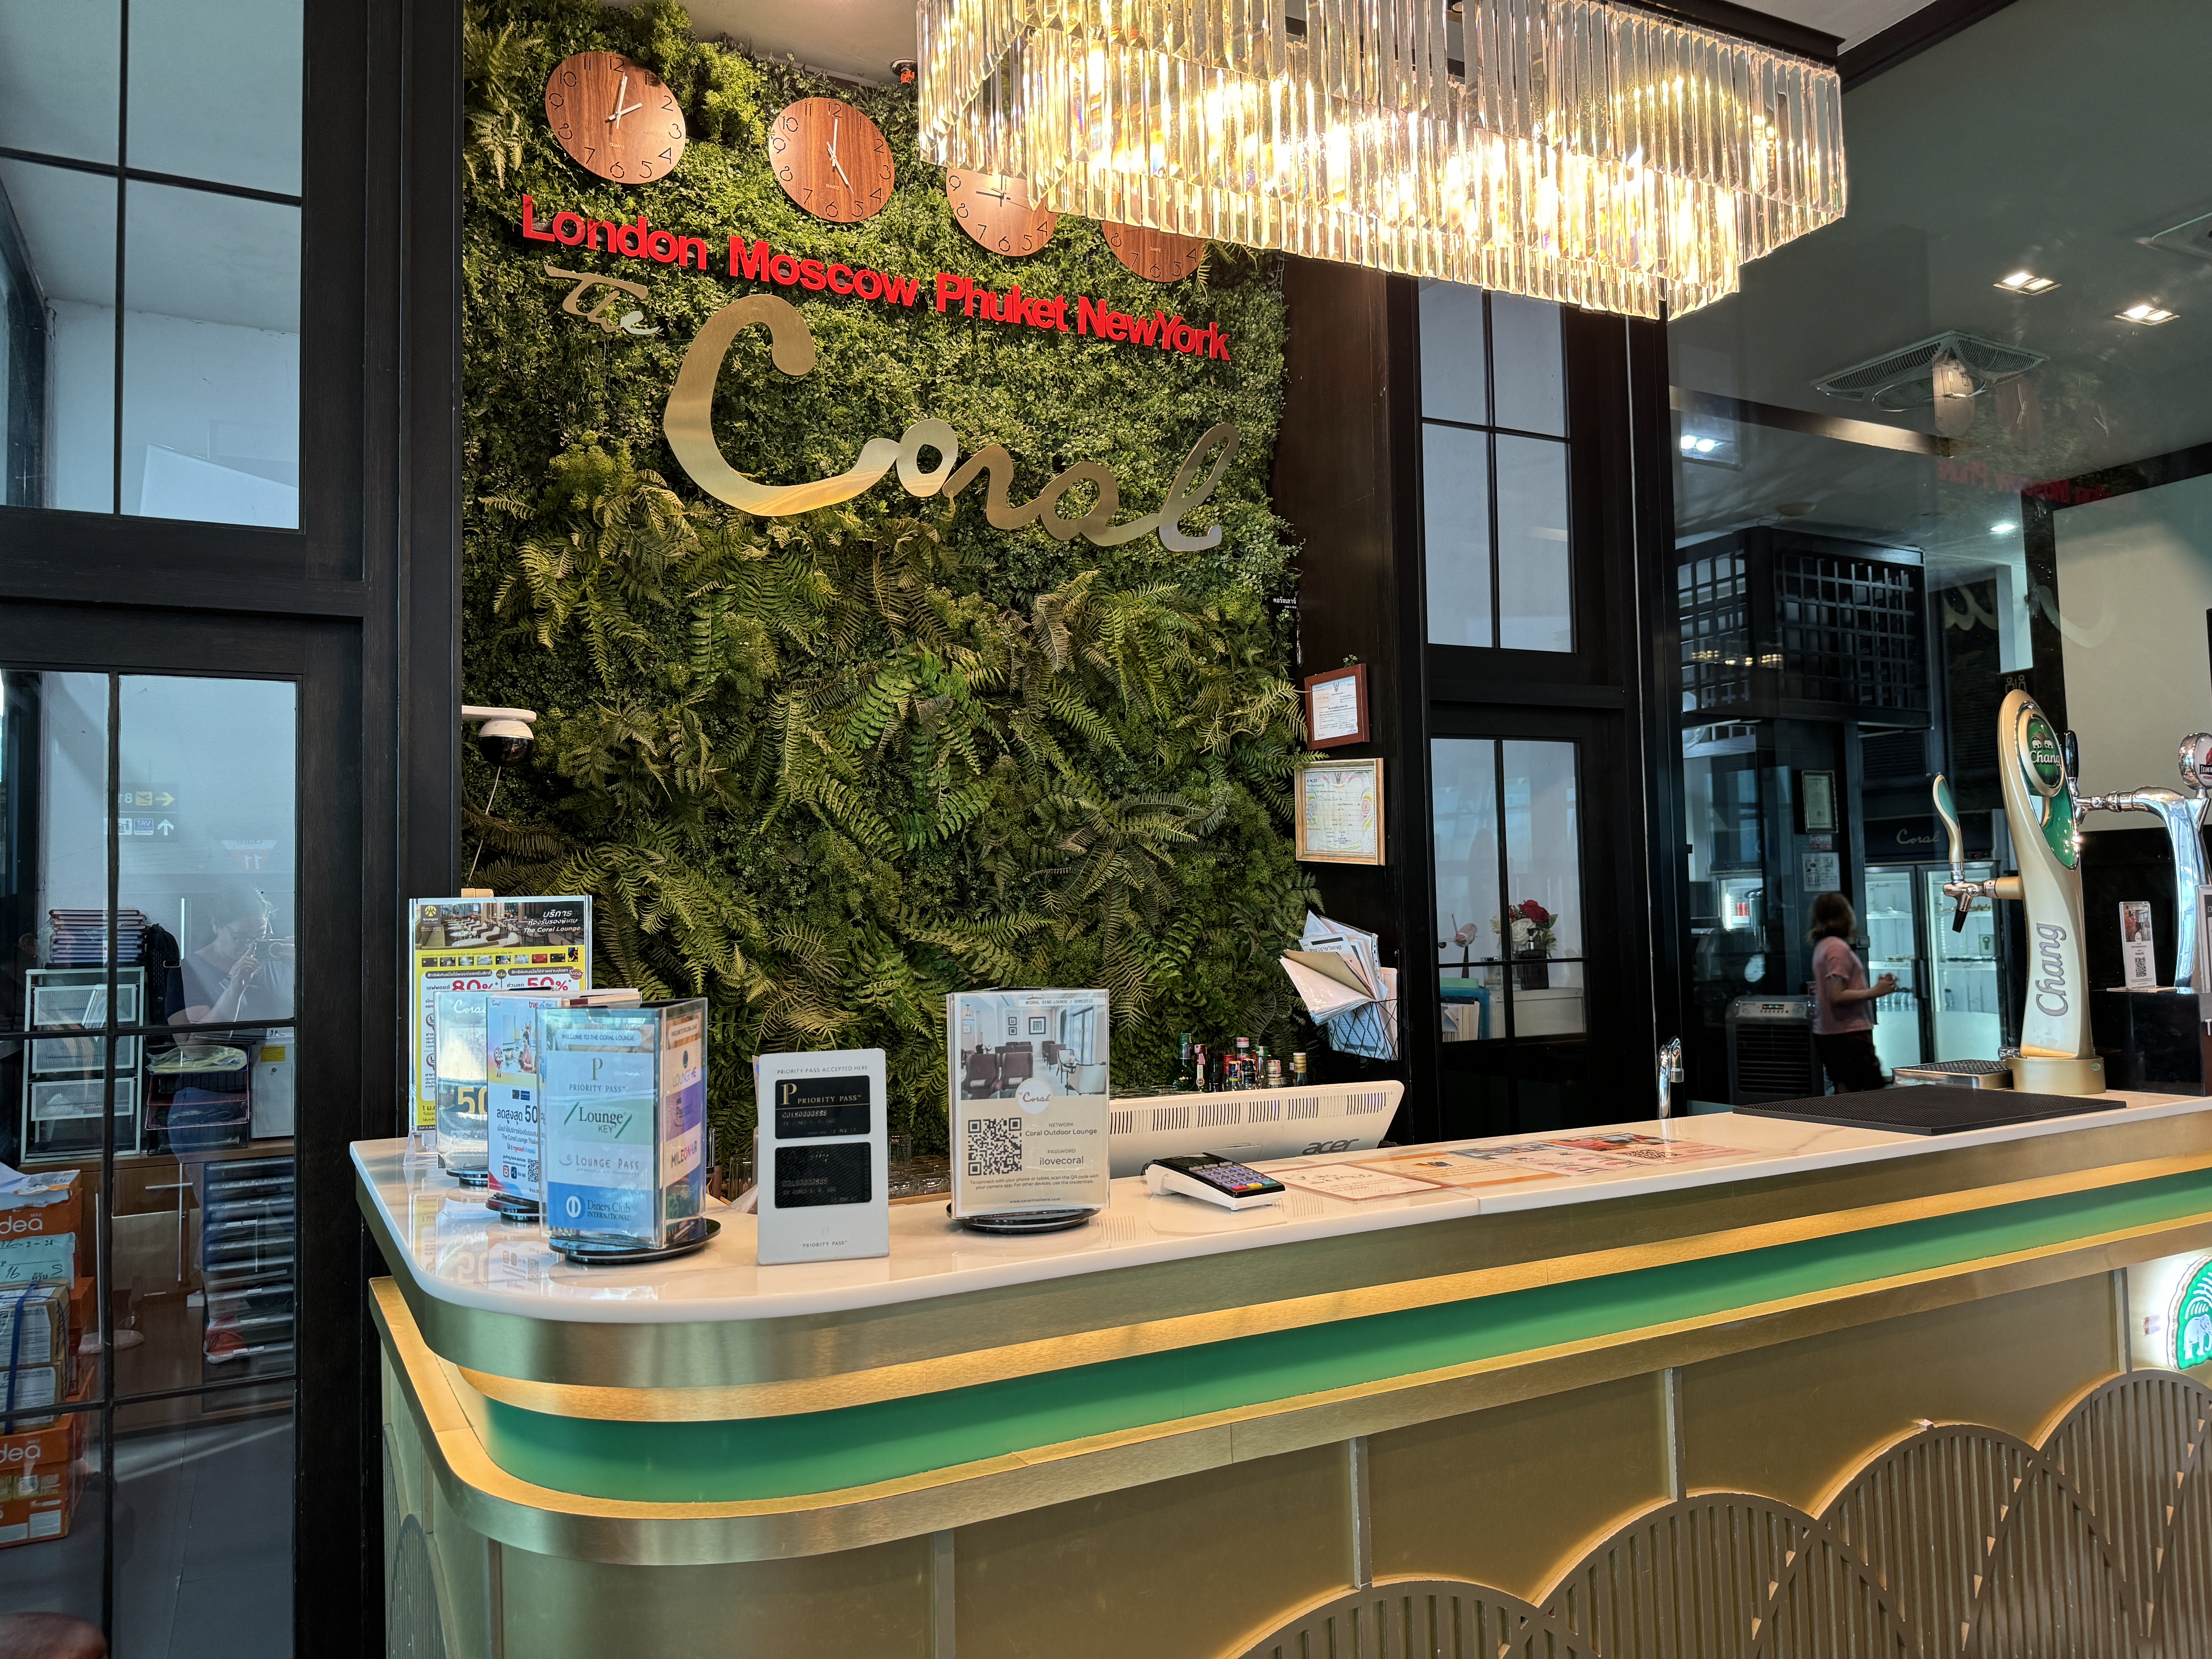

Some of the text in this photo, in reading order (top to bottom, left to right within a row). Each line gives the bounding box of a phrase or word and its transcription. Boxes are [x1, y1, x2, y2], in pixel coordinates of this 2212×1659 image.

[584, 56, 591, 71] 11
[610, 56, 625, 73] 12
[560, 70, 577, 87] 10
[644, 72, 647, 85] 1
[549, 93, 563, 110] 9
[661, 96, 673, 111] 2
[805, 102, 812, 117] 11
[828, 102, 842, 118] 12
[558, 123, 572, 139] 8
[669, 123, 682, 139] 3
[782, 116, 798, 132] 10
[859, 117, 862, 129] 1
[773, 138, 785, 153] 9
[874, 139, 884, 153] 2
[584, 147, 595, 164] 7
[658, 148, 671, 164] 4
[610, 161, 624, 178] 6
[639, 161, 652, 178] 5
[780, 166, 793, 181] 8
[879, 165, 891, 180] 3
[949, 175, 961, 191] 9
[804, 188, 813, 204] 7
[869, 187, 881, 203] 4
[826, 201, 838, 217] 6
[852, 201, 864, 217] 5
[957, 203, 969, 218] 8
[523, 194, 707, 270] London
[977, 224, 987, 240] 7
[1037, 221, 1048, 236] 4
[998, 236, 1010, 252] 6
[1022, 235, 1032, 251] 5
[1111, 233, 1121, 247] 8
[1130, 252, 1139, 267] 7
[1186, 248, 1196, 262] 4
[730, 235, 919, 307] Moscow
[1150, 263, 1161, 278] 6
[1172, 261, 1182, 276] 5
[936, 272, 1068, 332] Phuket
[1077, 295, 1231, 362] NewYork
[663, 294, 1241, 551] Coral
[2030, 750, 2061, 766] Chang
[1896, 829, 1939, 844] Coral
[2035, 923, 2068, 1016] Chang
[1023, 1092, 1051, 1102] Coral
[497, 1109, 523, 1125] ลดสูงสุด
[516, 1136, 527, 1144] Lounge
[1302, 1139, 1360, 1155] acer
[576, 1155, 639, 1170] LOUNGE PASS
[1040, 1156, 1084, 1165] ilovecoral
[587, 1200, 630, 1213] Diners Club
[587, 1211, 631, 1220] INTERNATIONAL
